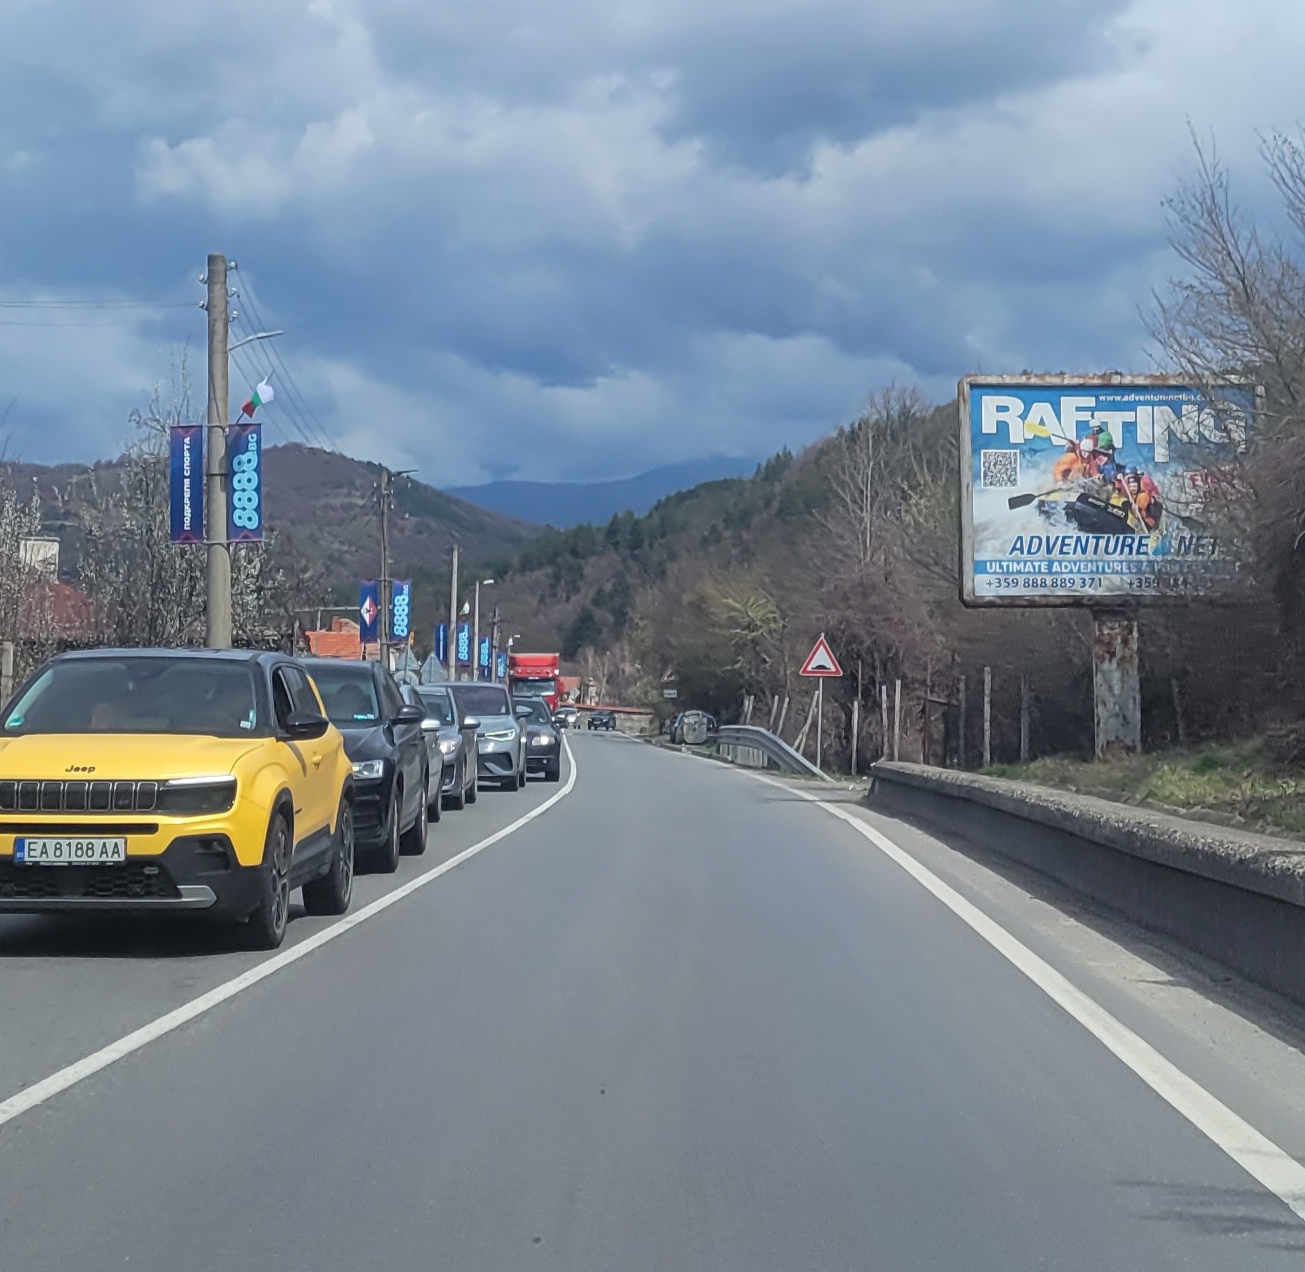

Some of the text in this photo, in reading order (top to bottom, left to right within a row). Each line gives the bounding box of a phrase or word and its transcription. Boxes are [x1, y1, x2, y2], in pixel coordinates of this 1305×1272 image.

[981, 395, 1247, 463] RAFTING
[183, 436, 191, 477] СПОРТА
[232, 433, 259, 530] 8888.BG
[1009, 535, 1150, 557] ADVENTURE
[986, 561, 1049, 574] ULTIMATE
[1051, 561, 1137, 574] ADVENTURES
[986, 577, 1019, 589] +359
[1022, 577, 1049, 589] 888
[1050, 577, 1076, 589] 889
[1079, 577, 1103, 589] 371
[65, 765, 96, 773] Jeep
[27, 841, 121, 859] EA 8188 AA
